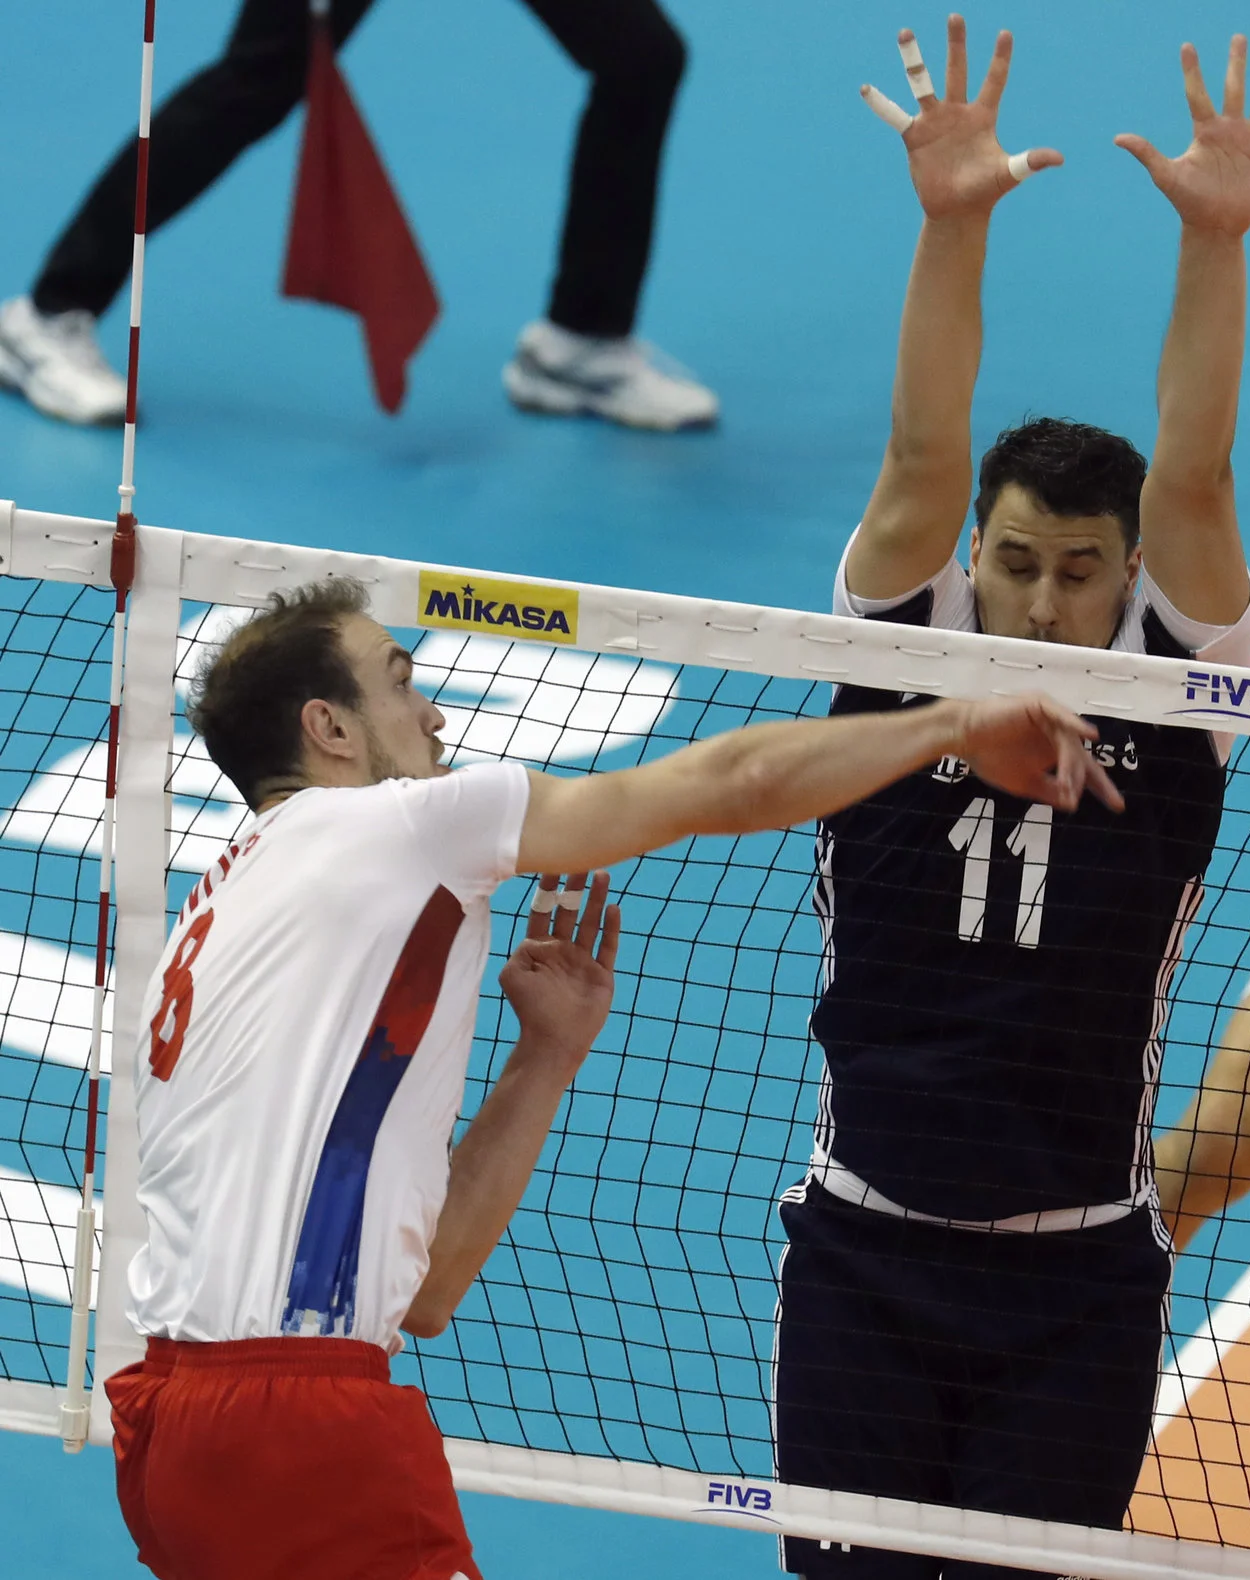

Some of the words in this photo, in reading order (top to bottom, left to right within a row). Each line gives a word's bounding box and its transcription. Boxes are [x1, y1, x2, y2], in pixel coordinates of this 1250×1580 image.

[424, 584, 571, 634] MIKASA
[947, 797, 1053, 950] 11
[148, 906, 215, 1083] 8
[707, 1482, 773, 1511] FIVB
